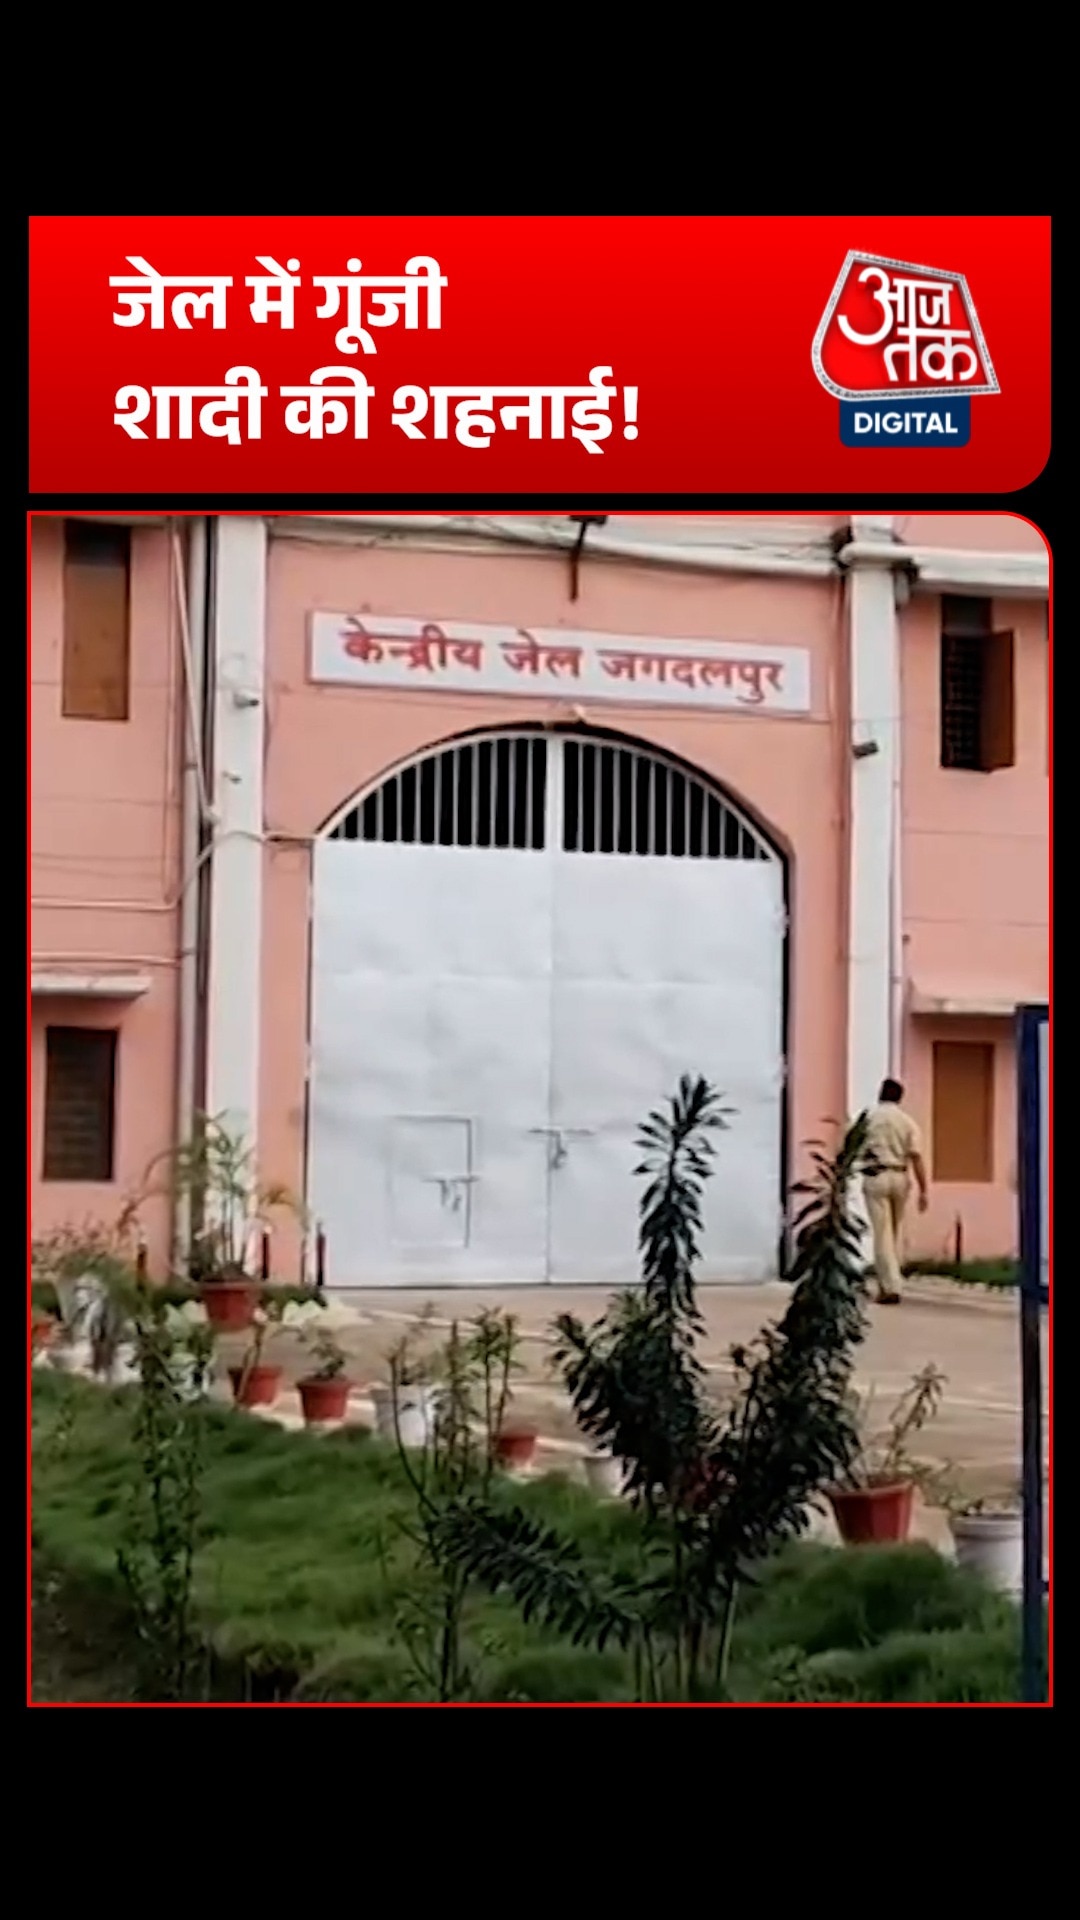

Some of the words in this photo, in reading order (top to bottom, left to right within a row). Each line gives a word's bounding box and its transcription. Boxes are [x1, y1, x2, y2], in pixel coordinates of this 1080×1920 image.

[340, 616, 483, 672] केन्द्रीय
[499, 628, 583, 678] जेल
[597, 649, 784, 705] जगदलपुर
